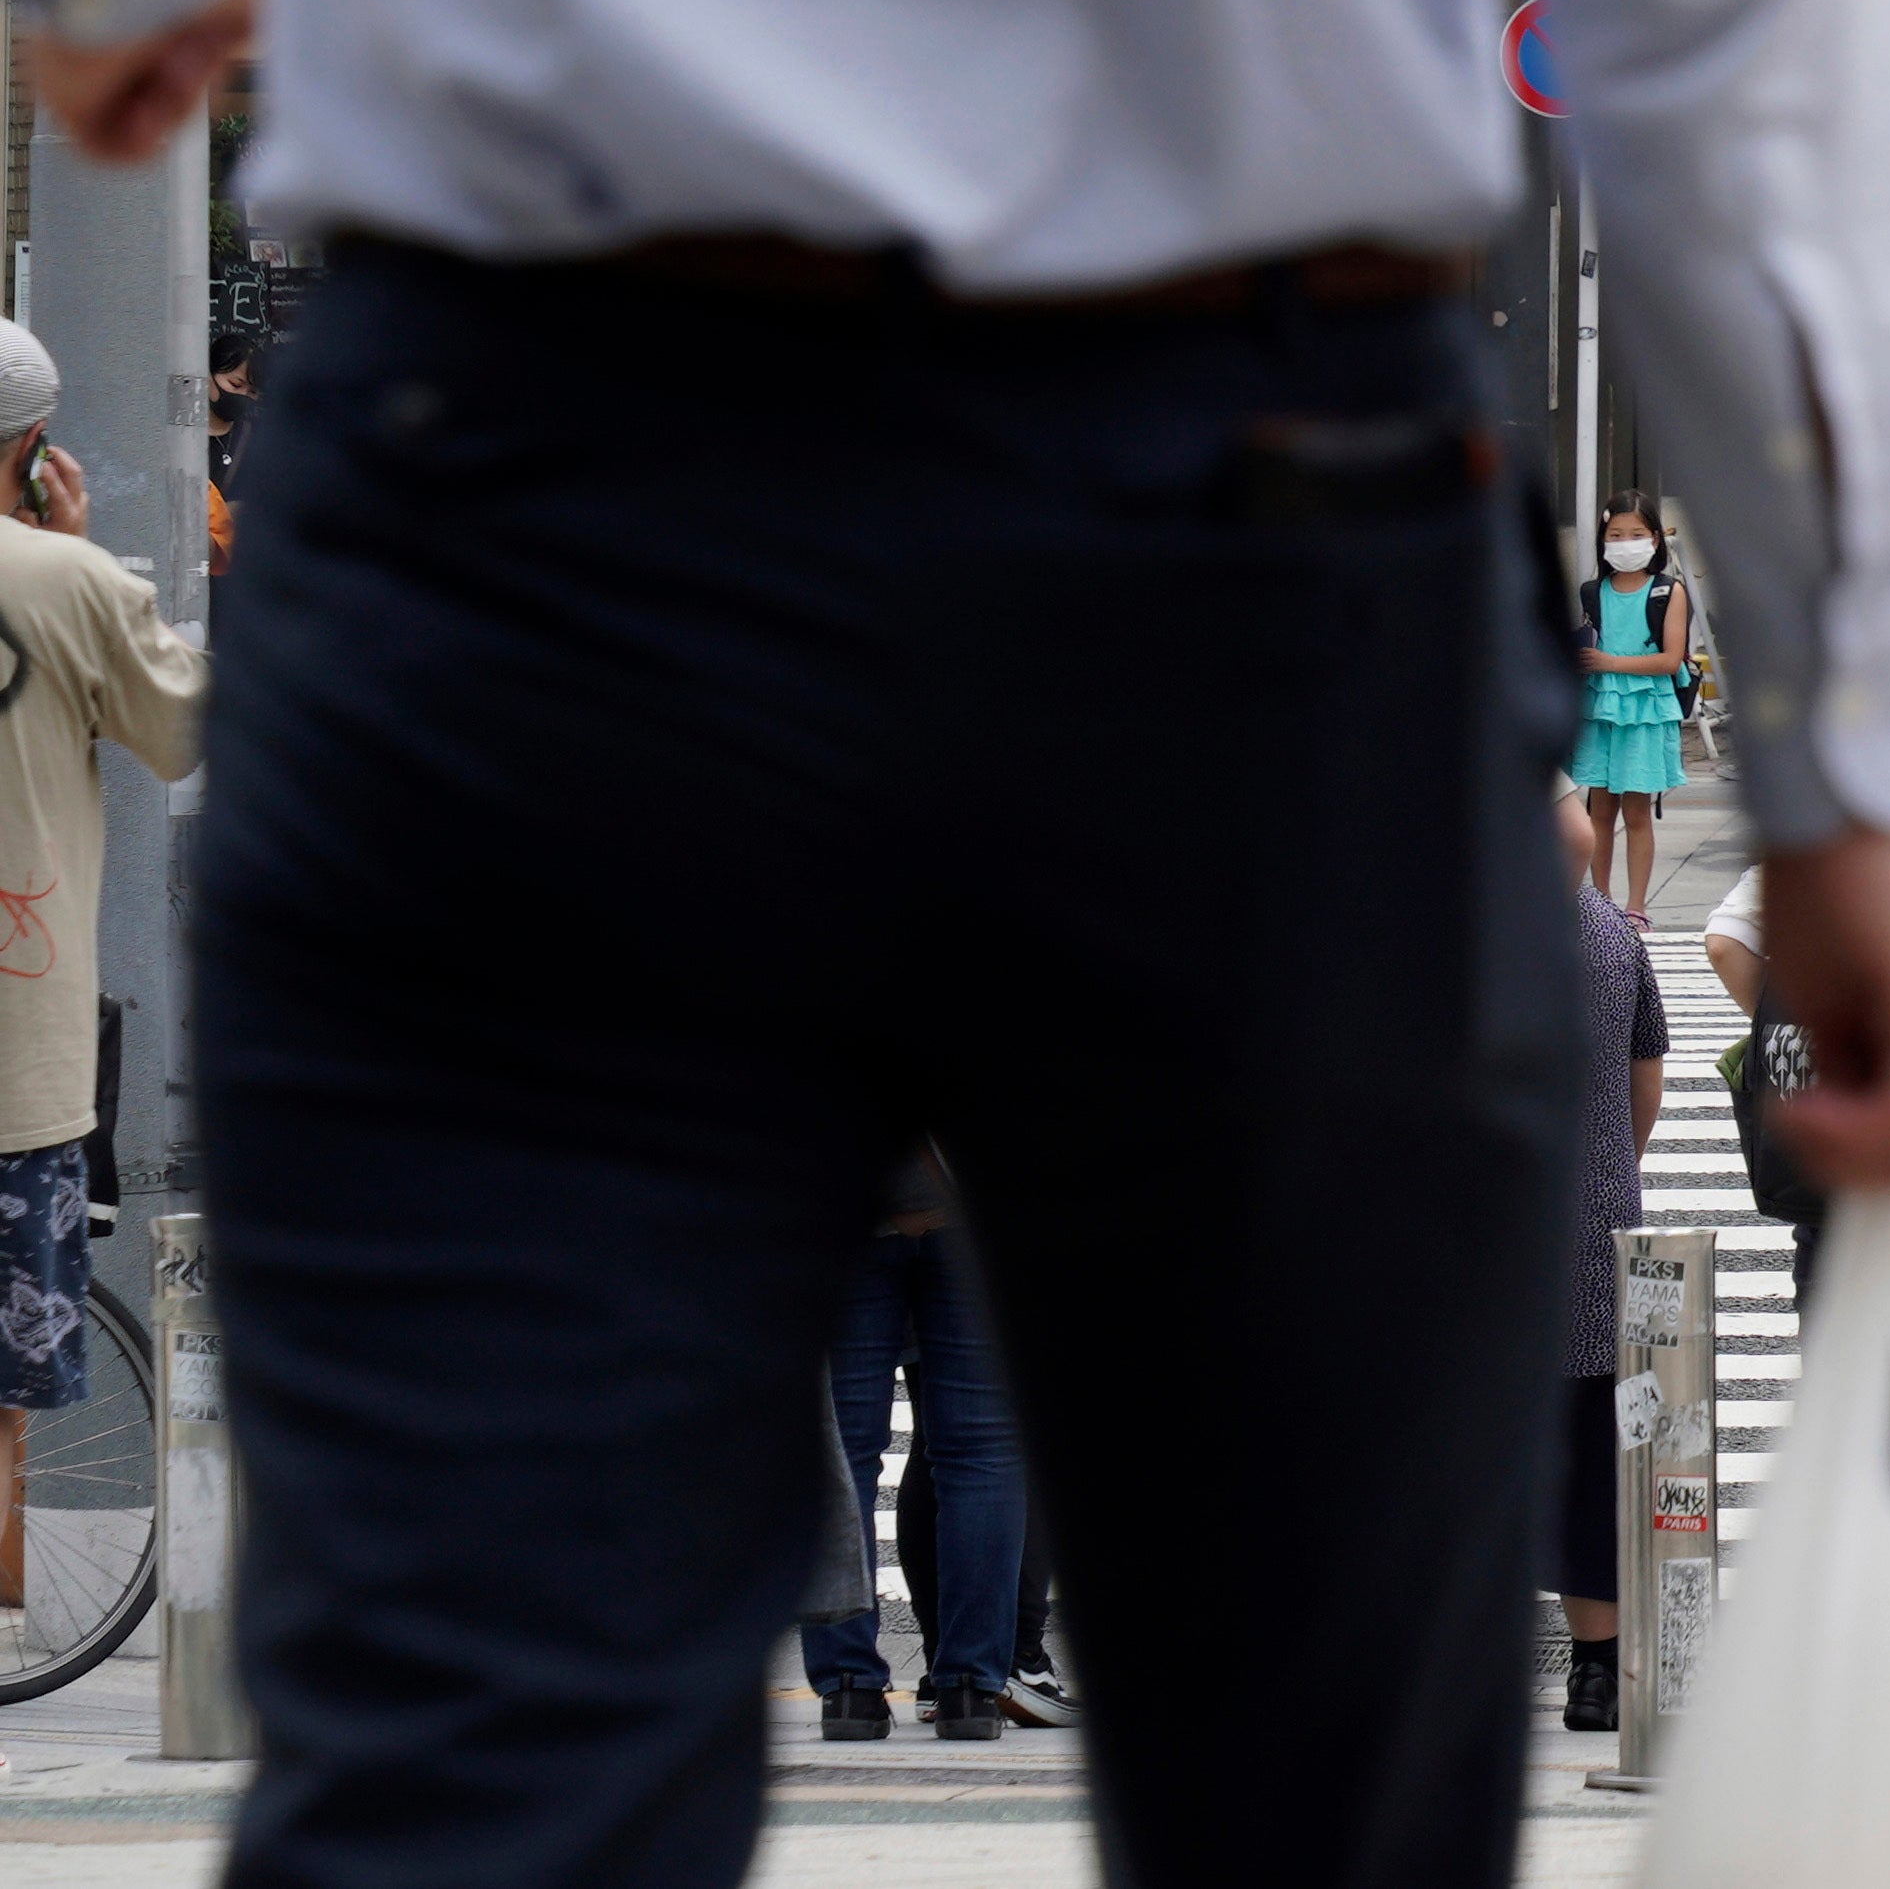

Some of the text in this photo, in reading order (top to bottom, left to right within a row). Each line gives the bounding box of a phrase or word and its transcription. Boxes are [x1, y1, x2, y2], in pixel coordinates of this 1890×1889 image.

[1636, 1260, 1676, 1279] PKS
[1629, 1281, 1681, 1304] YAMA
[1661, 1516, 1702, 1530] PARIS
